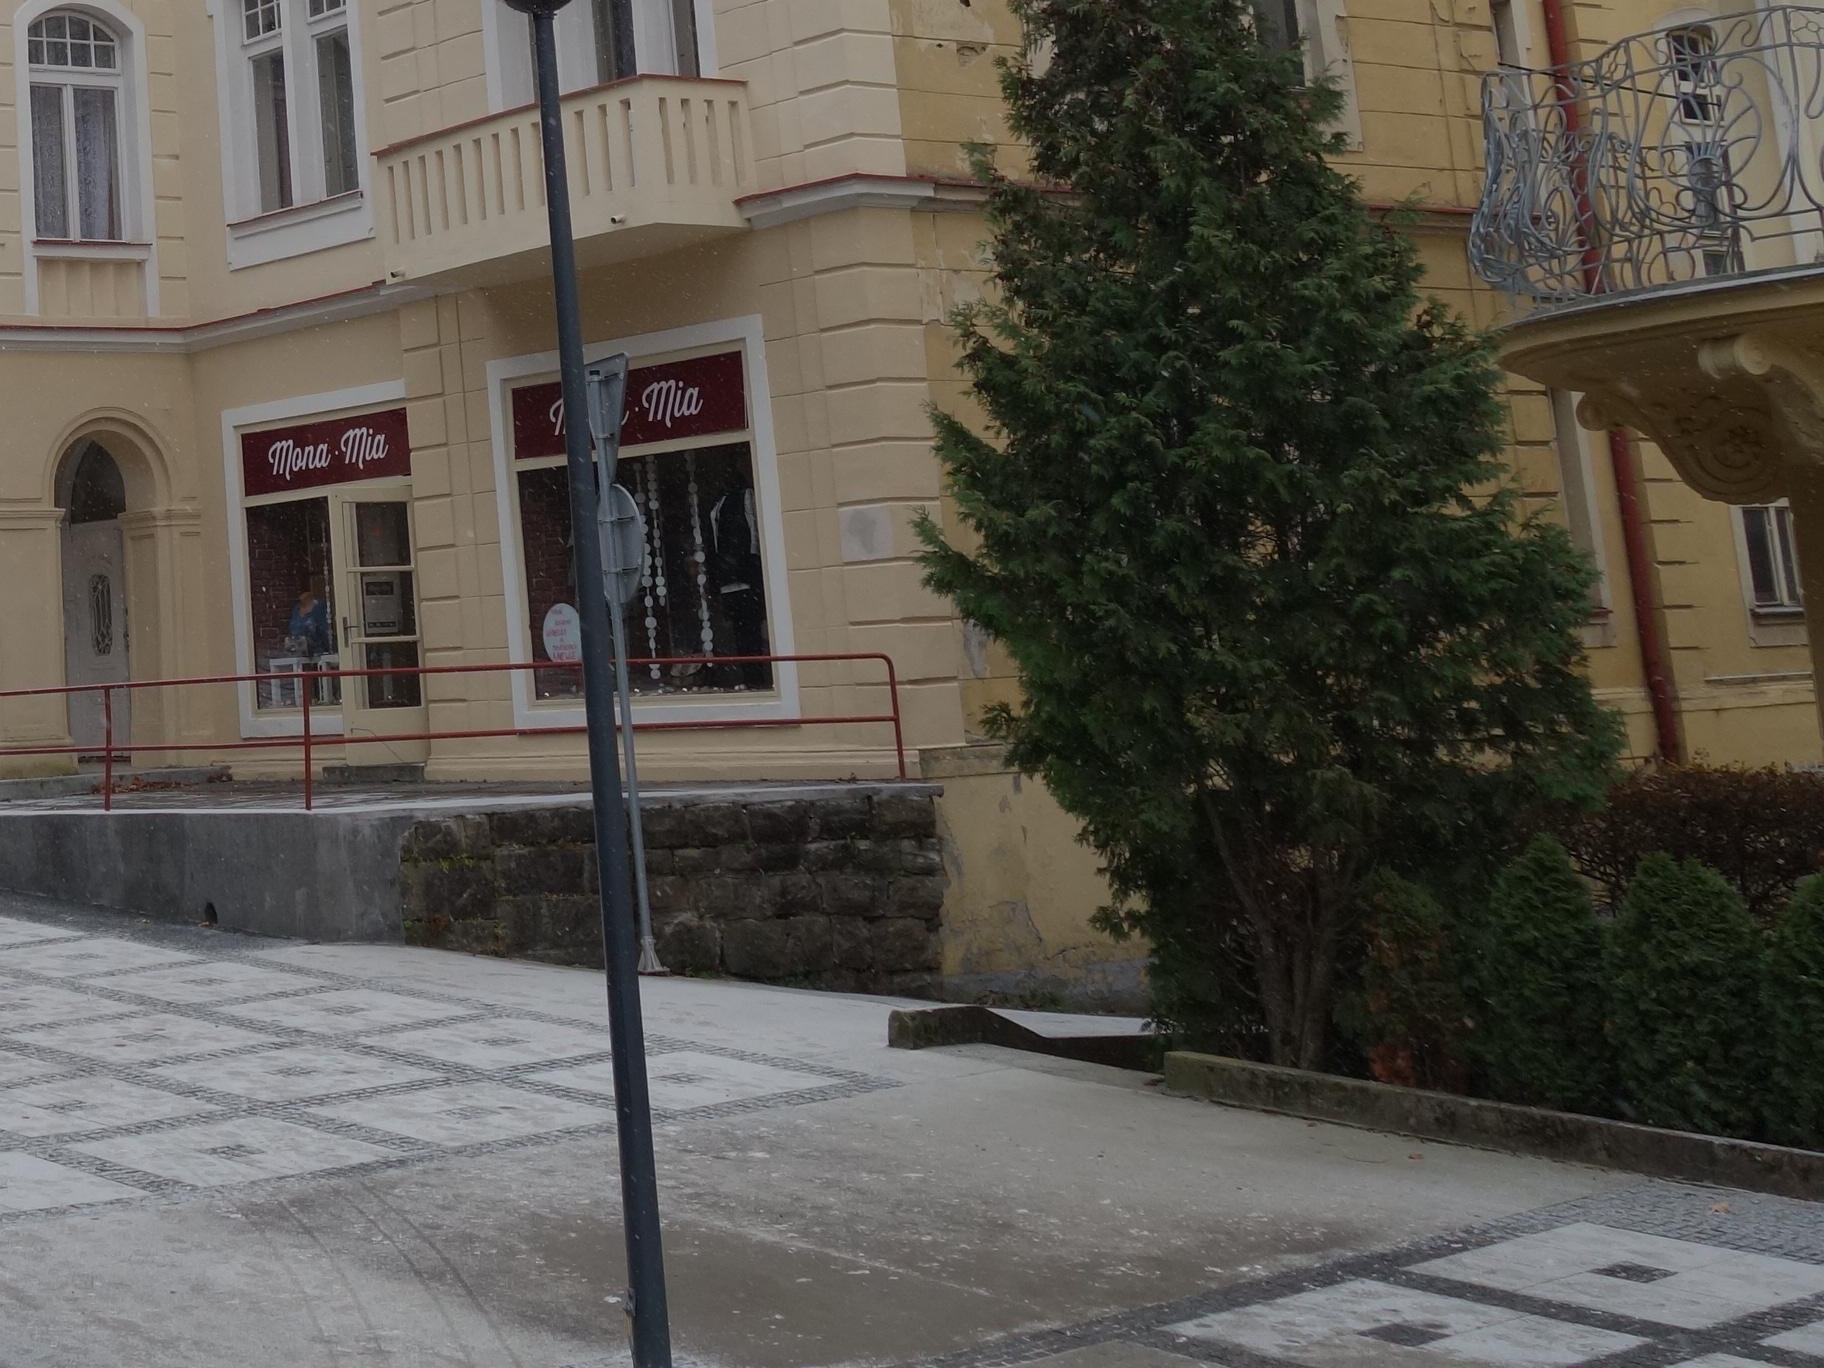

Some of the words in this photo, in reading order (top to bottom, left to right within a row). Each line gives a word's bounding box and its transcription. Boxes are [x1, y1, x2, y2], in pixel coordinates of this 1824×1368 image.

[641, 378, 704, 429] Mia
[267, 438, 332, 481] Mona
[340, 426, 389, 470] Mia
